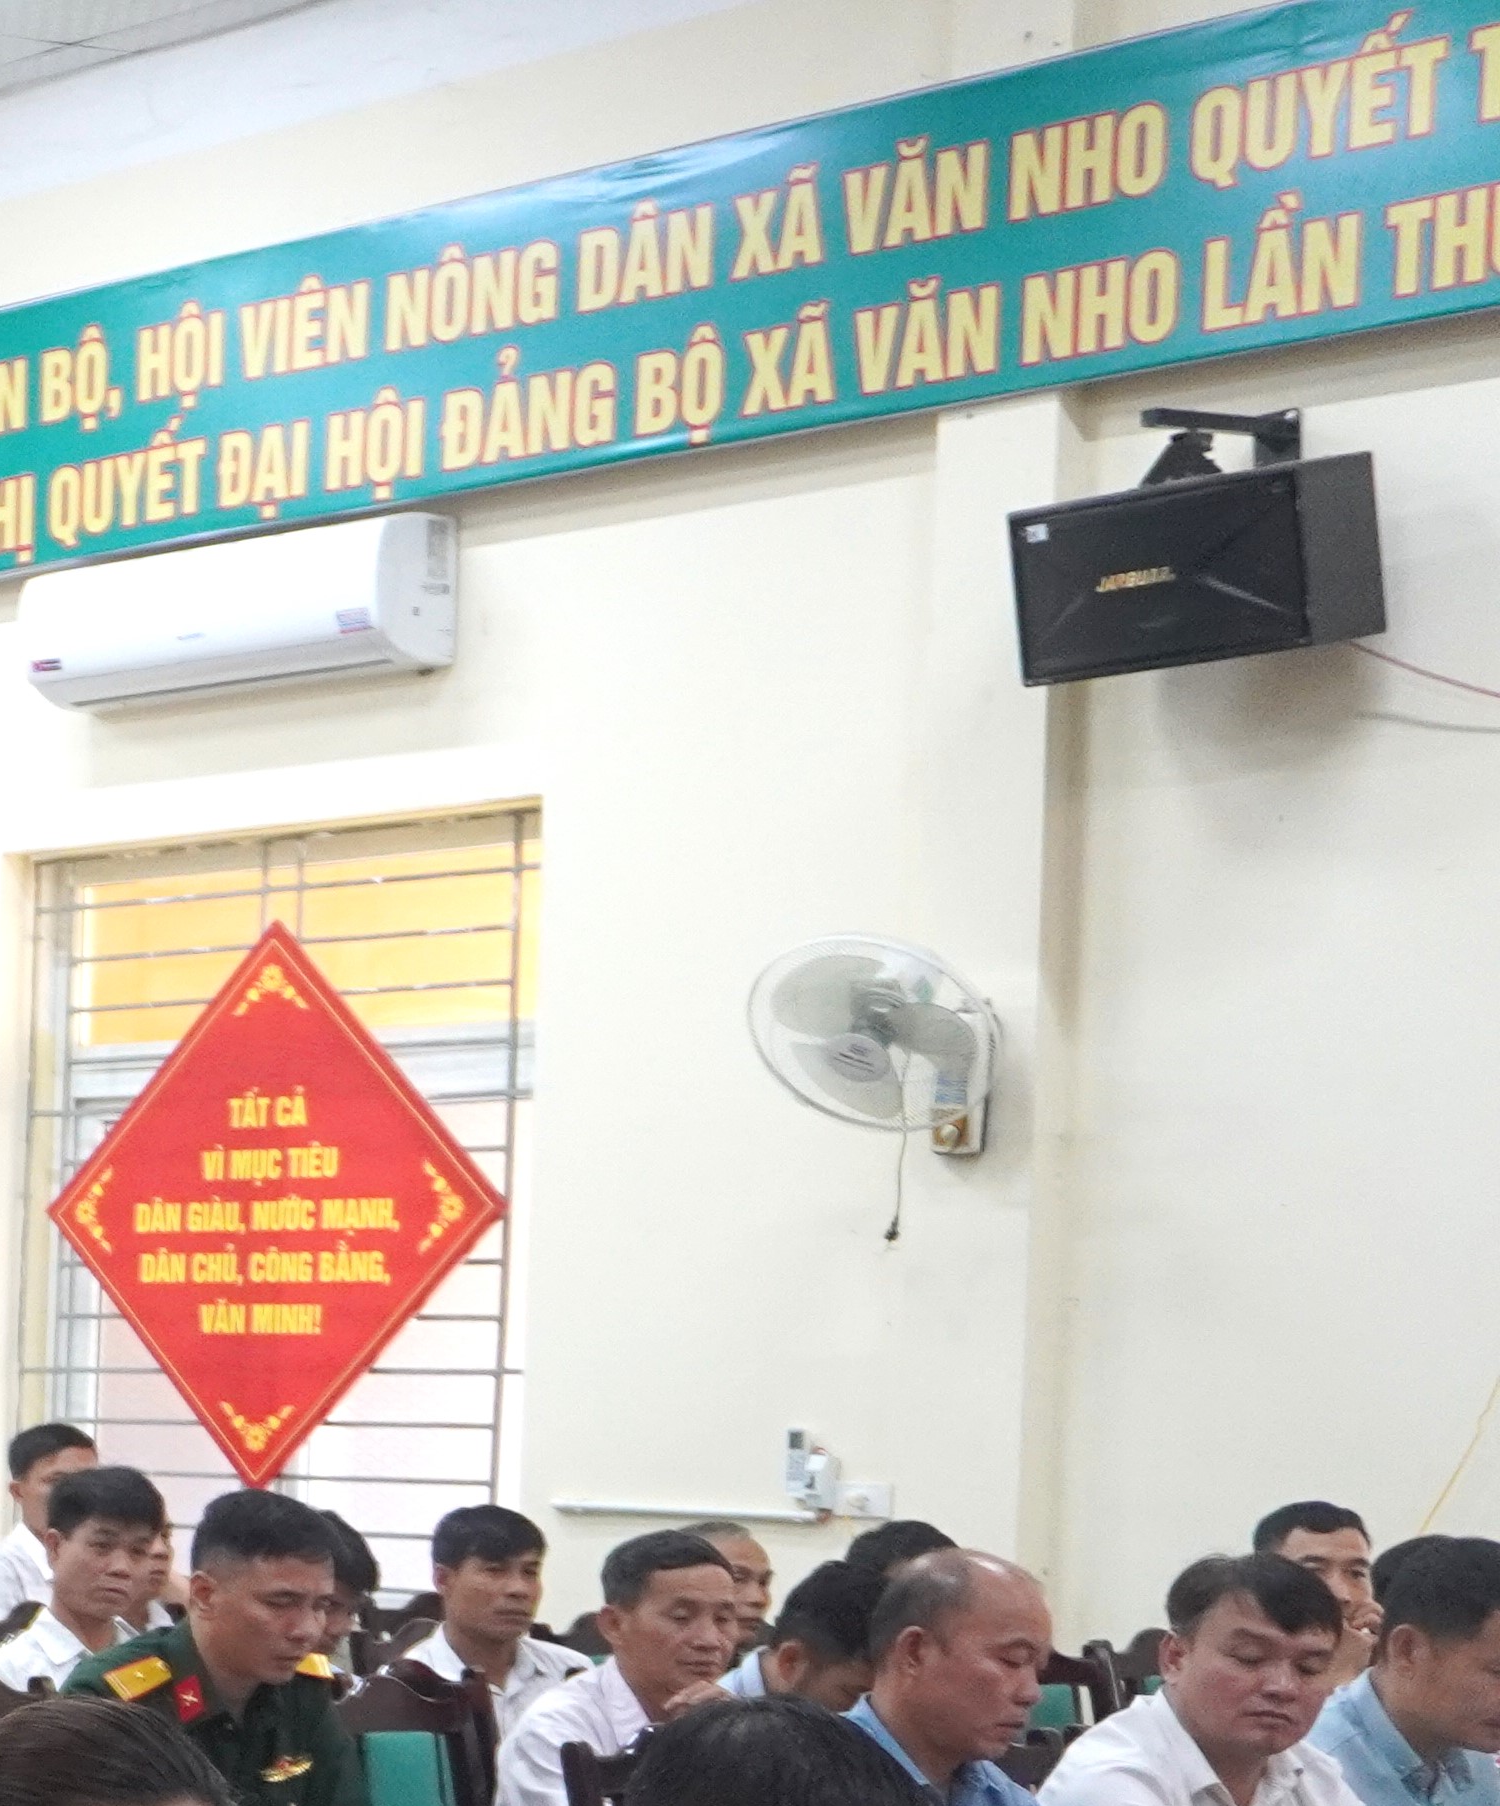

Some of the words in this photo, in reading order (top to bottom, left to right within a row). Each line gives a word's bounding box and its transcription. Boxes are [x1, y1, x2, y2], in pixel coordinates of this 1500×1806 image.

[40, 324, 122, 430] BỘ,
[137, 301, 225, 409] HỘI
[239, 274, 370, 381] VIÊN
[384, 243, 559, 352] NÔNG
[577, 202, 713, 313] DÂN
[730, 163, 824, 281] XÃ
[843, 136, 990, 256] VĂN
[1007, 101, 1167, 222] NHO
[1190, 9, 1450, 191] QUYẾT
[48, 415, 207, 547] QUYẾT
[217, 419, 309, 520] ĐẠI
[325, 386, 425, 499] HỘI
[440, 345, 616, 472] ĐẢNG
[634, 323, 724, 446] BỘ
[740, 300, 835, 416] XÃ
[854, 276, 1000, 395] VĂN
[1020, 248, 1178, 367] NHO
[1201, 189, 1361, 334] LẦN
[1384, 181, 1500, 298] TH
[227, 1085, 270, 1128] TẤT
[274, 1084, 308, 1127] CẢ
[202, 1143, 224, 1181] VÌ
[229, 1148, 283, 1187] MỤC
[287, 1140, 339, 1179] TIÊU
[134, 1197, 182, 1233] DÂN
[187, 1195, 247, 1235] GIÀU,
[251, 1193, 316, 1231] NƯỚC
[320, 1198, 401, 1237] MẠNH,
[139, 1247, 186, 1284] DÂN
[191, 1242, 244, 1287] CHỦ,
[249, 1246, 313, 1284] CÔNG
[318, 1239, 392, 1287] BẰNG,
[199, 1298, 246, 1335] VĂN
[251, 1303, 322, 1335] MINH!
